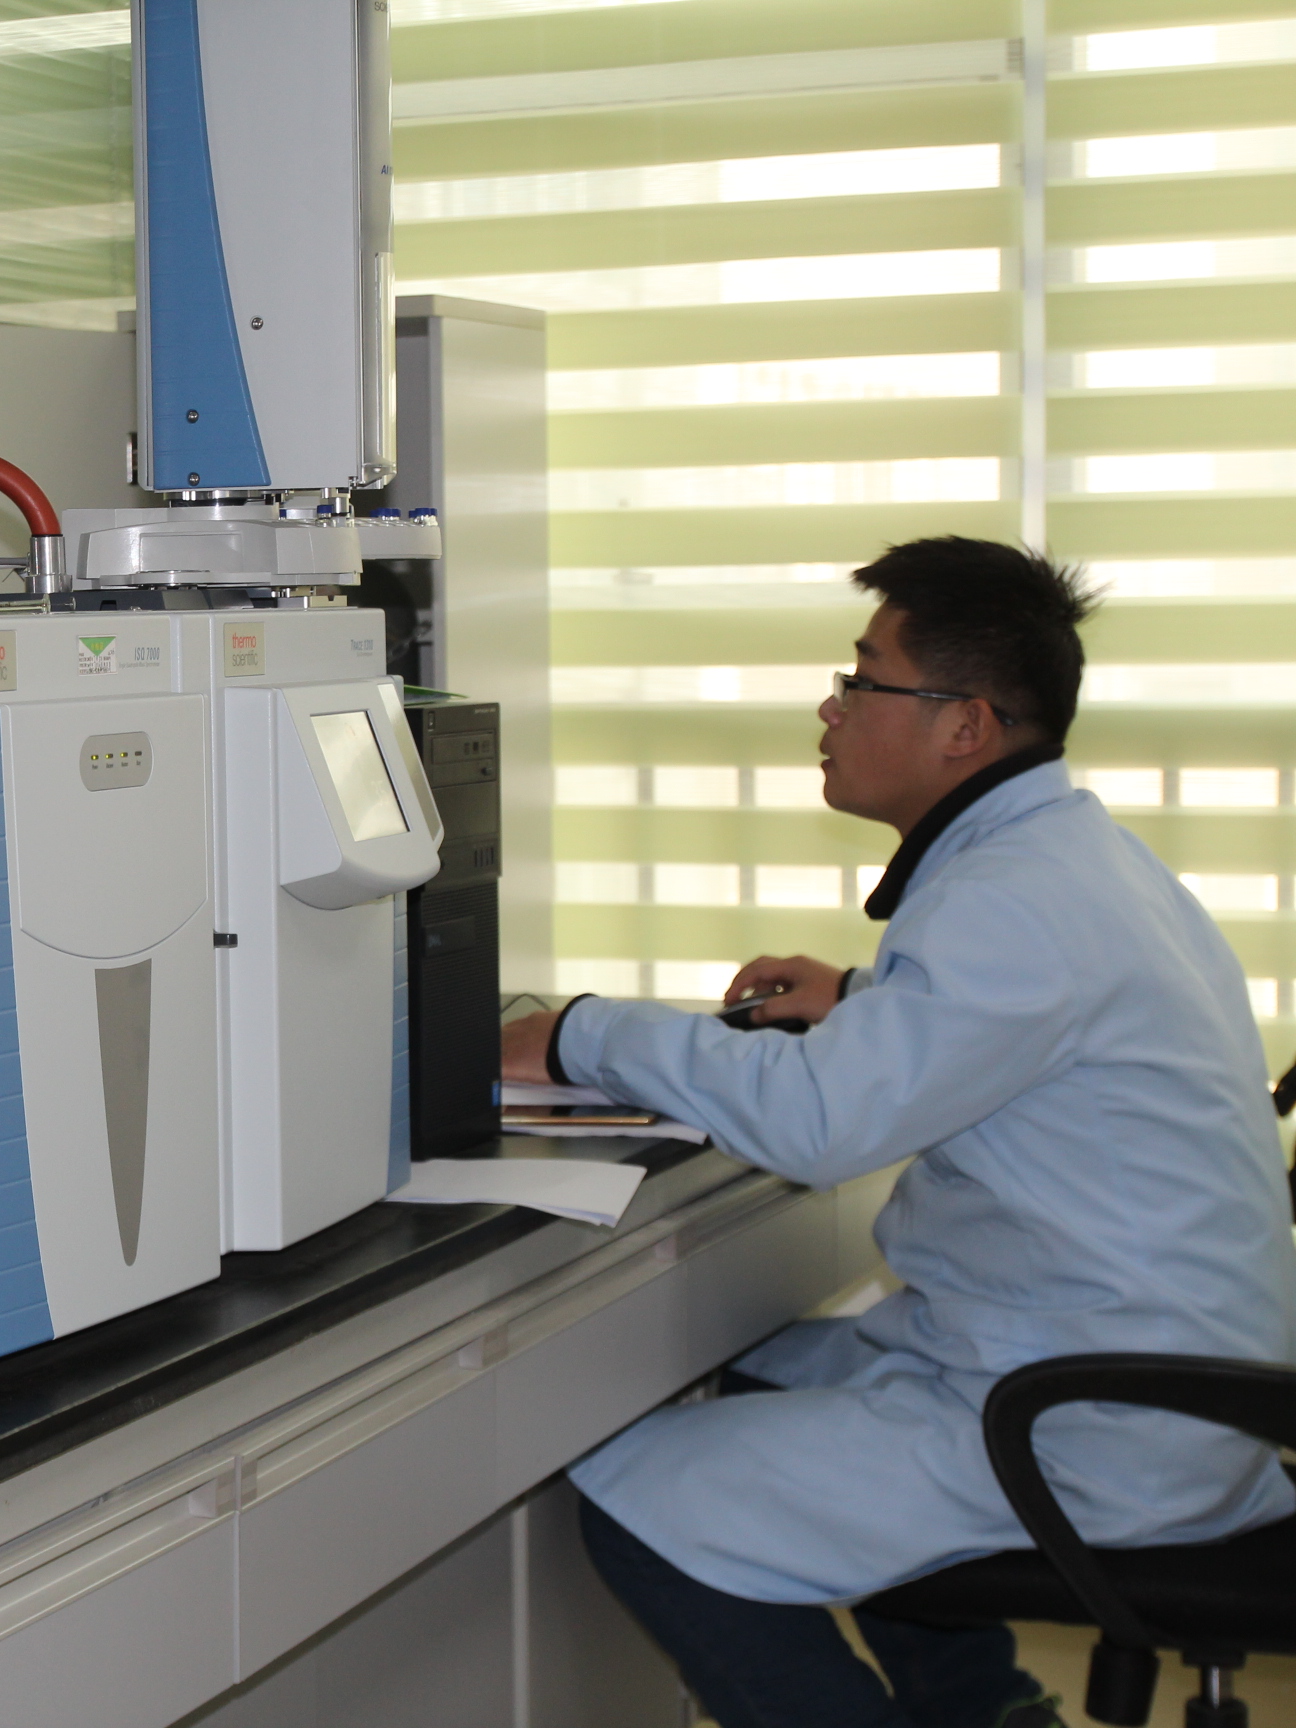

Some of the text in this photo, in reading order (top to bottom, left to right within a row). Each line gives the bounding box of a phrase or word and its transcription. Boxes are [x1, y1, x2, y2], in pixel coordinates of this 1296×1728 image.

[232, 632, 257, 649] thermo
[146, 647, 160, 660] 7000
[232, 649, 258, 667] scientific
